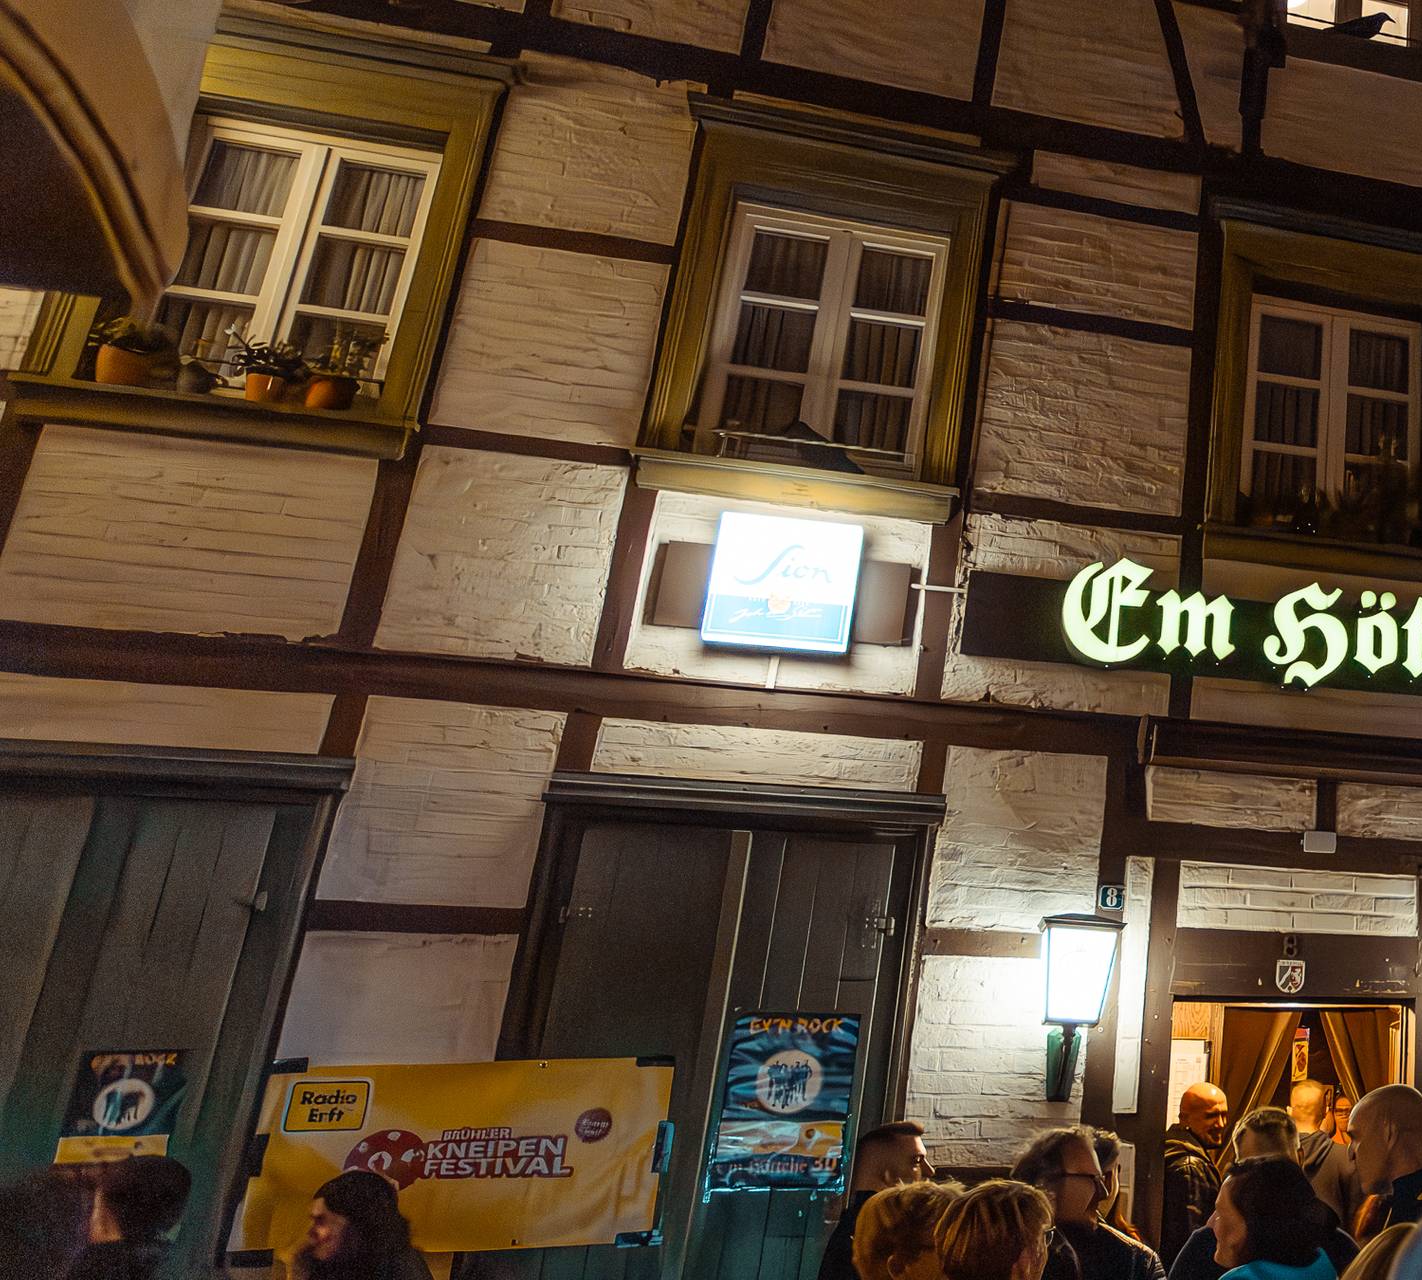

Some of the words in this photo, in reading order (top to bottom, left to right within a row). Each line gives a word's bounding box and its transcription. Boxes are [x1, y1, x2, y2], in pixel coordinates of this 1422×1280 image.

[1062, 557, 1235, 663] Em
[1106, 887, 1118, 907] 8
[1283, 934, 1297, 958] 8
[797, 1017, 845, 1036] ROCK
[301, 1089, 357, 1105] Radio
[308, 1107, 344, 1123] Erft
[443, 1127, 511, 1141] BRÜHLER
[427, 1137, 565, 1160] KNEIPEN
[424, 1156, 570, 1177] FESTIVAL
